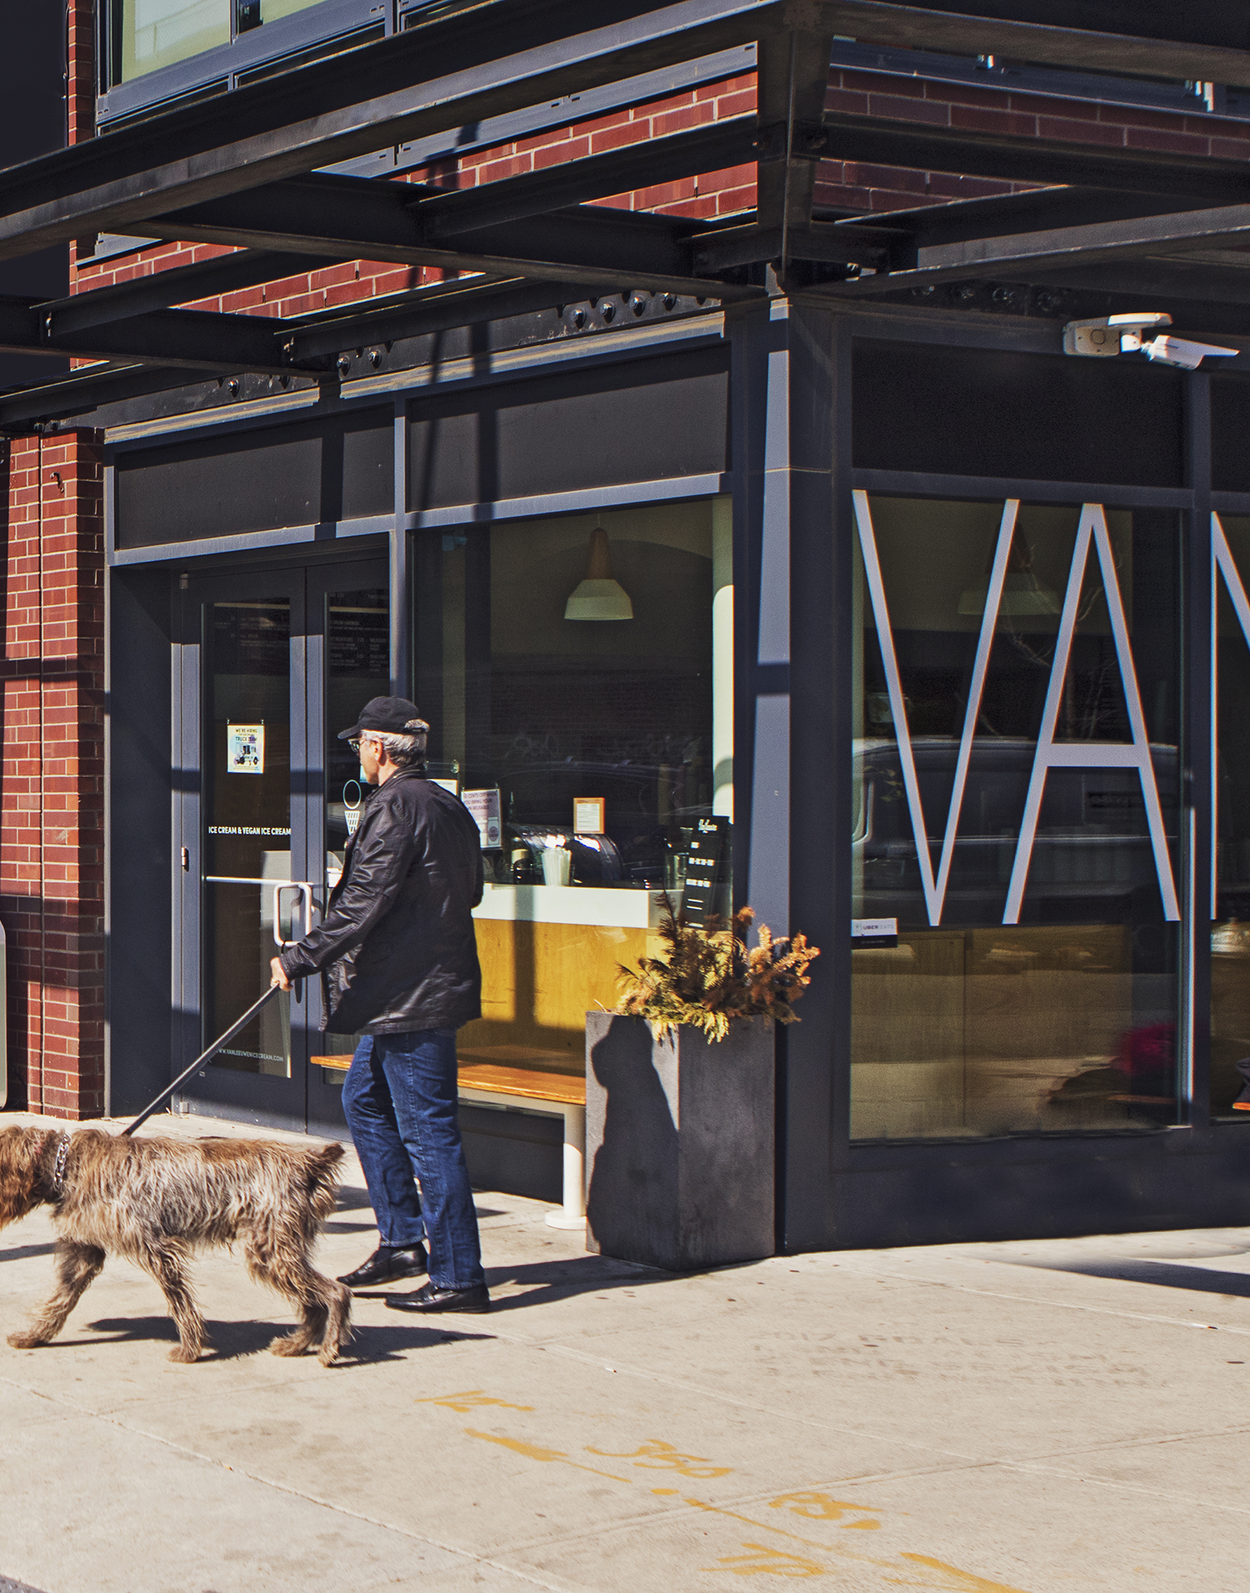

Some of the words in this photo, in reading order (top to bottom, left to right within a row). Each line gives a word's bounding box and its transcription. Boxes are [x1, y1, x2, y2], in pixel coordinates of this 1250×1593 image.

[852, 489, 1250, 927] VA
[208, 826, 218, 834] ICE
[218, 826, 237, 834] CREAM
[237, 826, 242, 834] &
[242, 827, 261, 835] VEGAN
[261, 827, 271, 835] ICE
[271, 827, 292, 836] CREAM
[584, 1439, 736, 1479] 350
